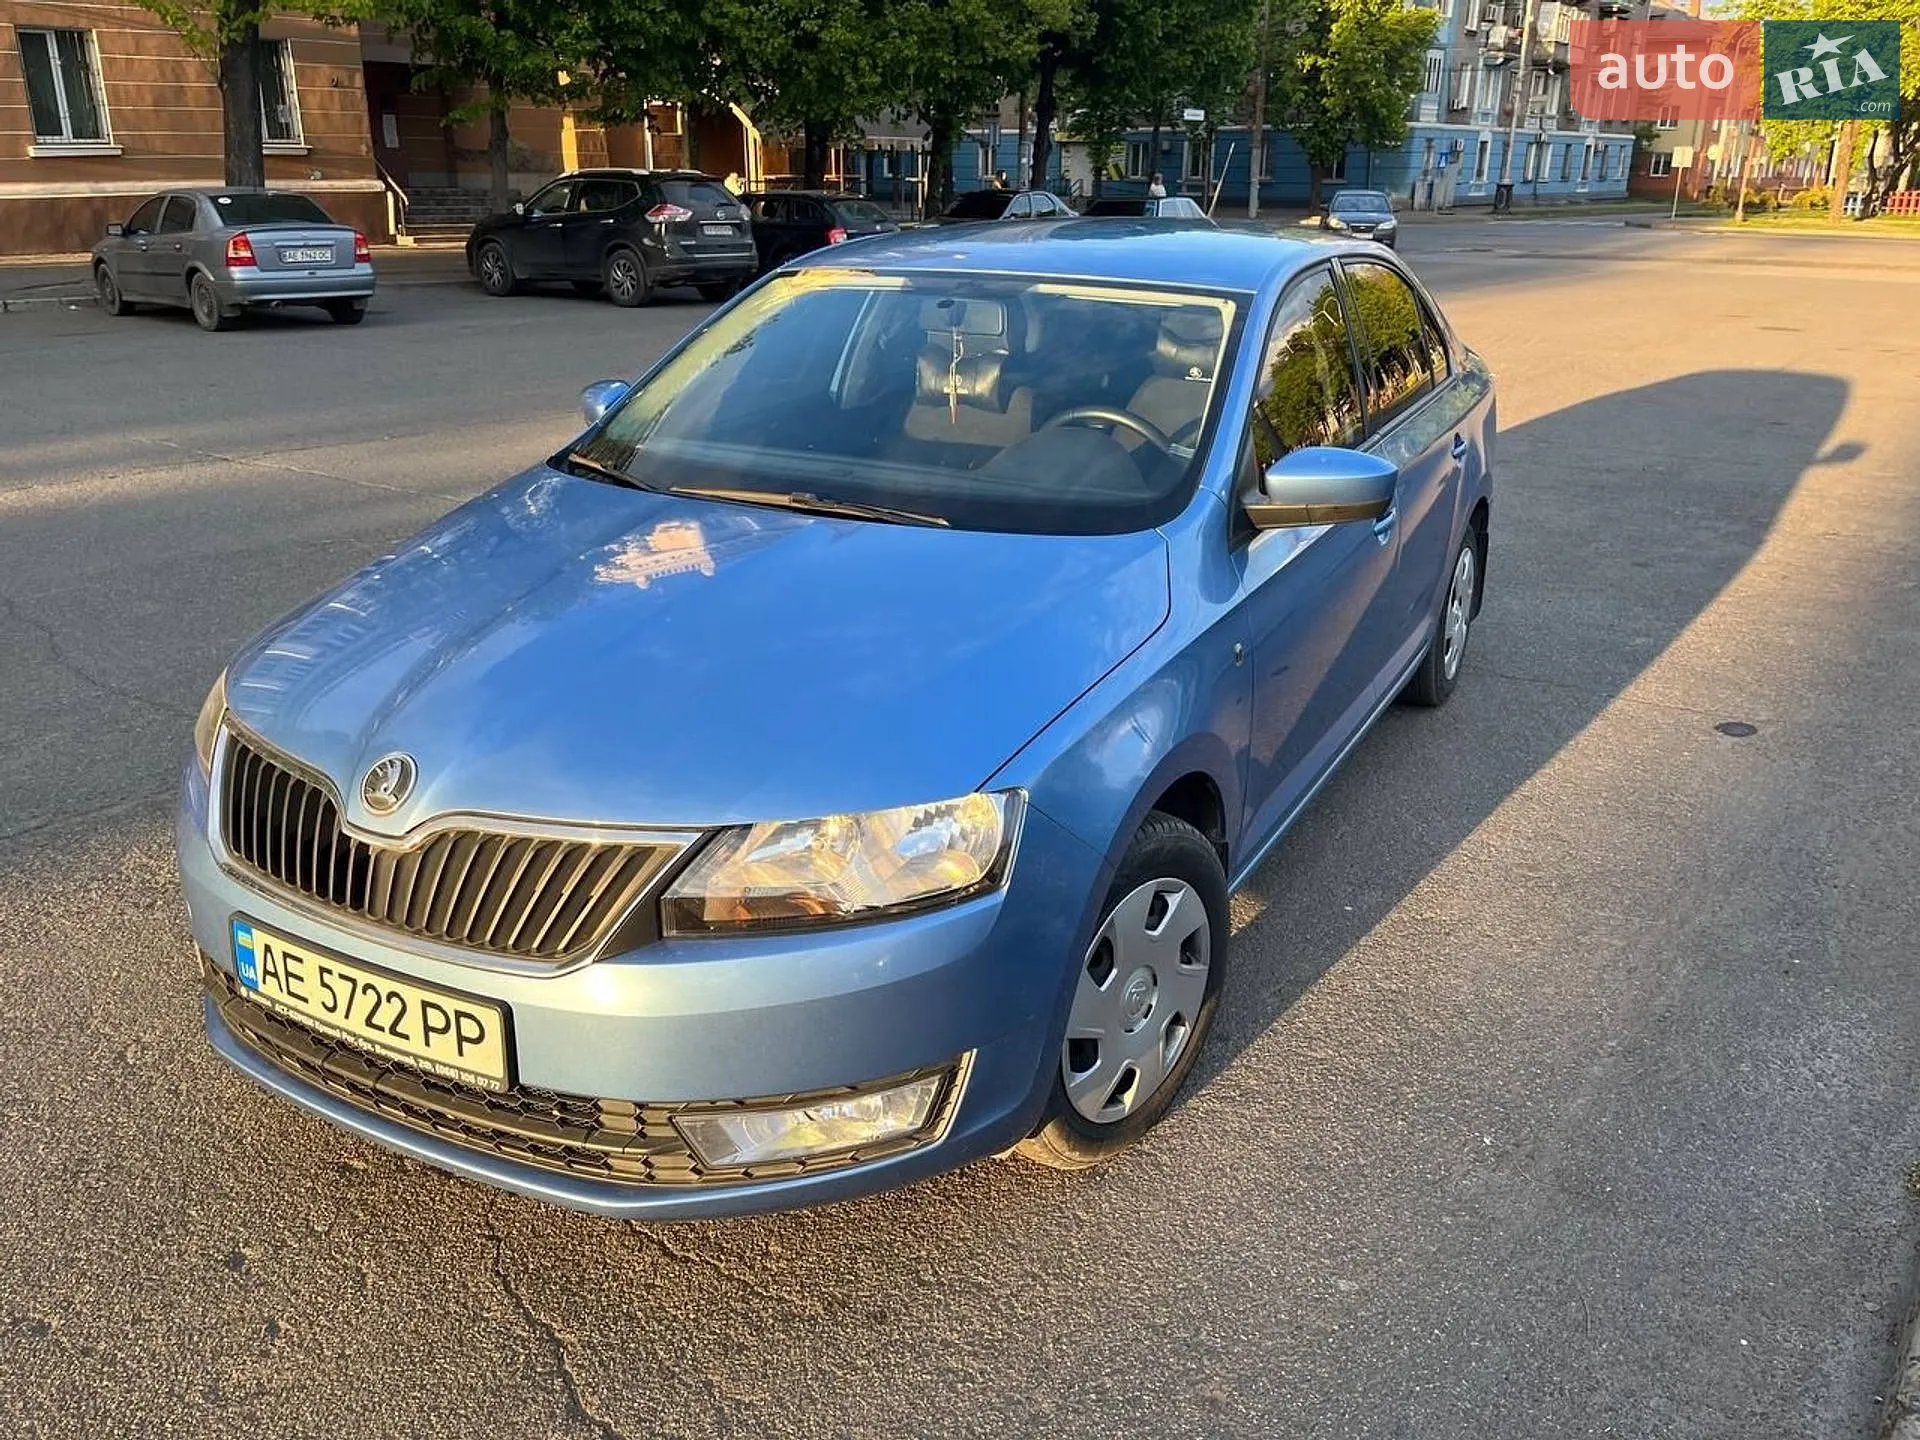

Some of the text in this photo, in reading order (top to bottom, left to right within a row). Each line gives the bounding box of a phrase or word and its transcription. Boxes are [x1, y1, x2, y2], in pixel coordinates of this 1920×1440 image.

[241, 961, 257, 982] UA
[262, 943, 309, 1004] AE
[318, 965, 411, 1041] 5722
[421, 999, 486, 1057] PP
